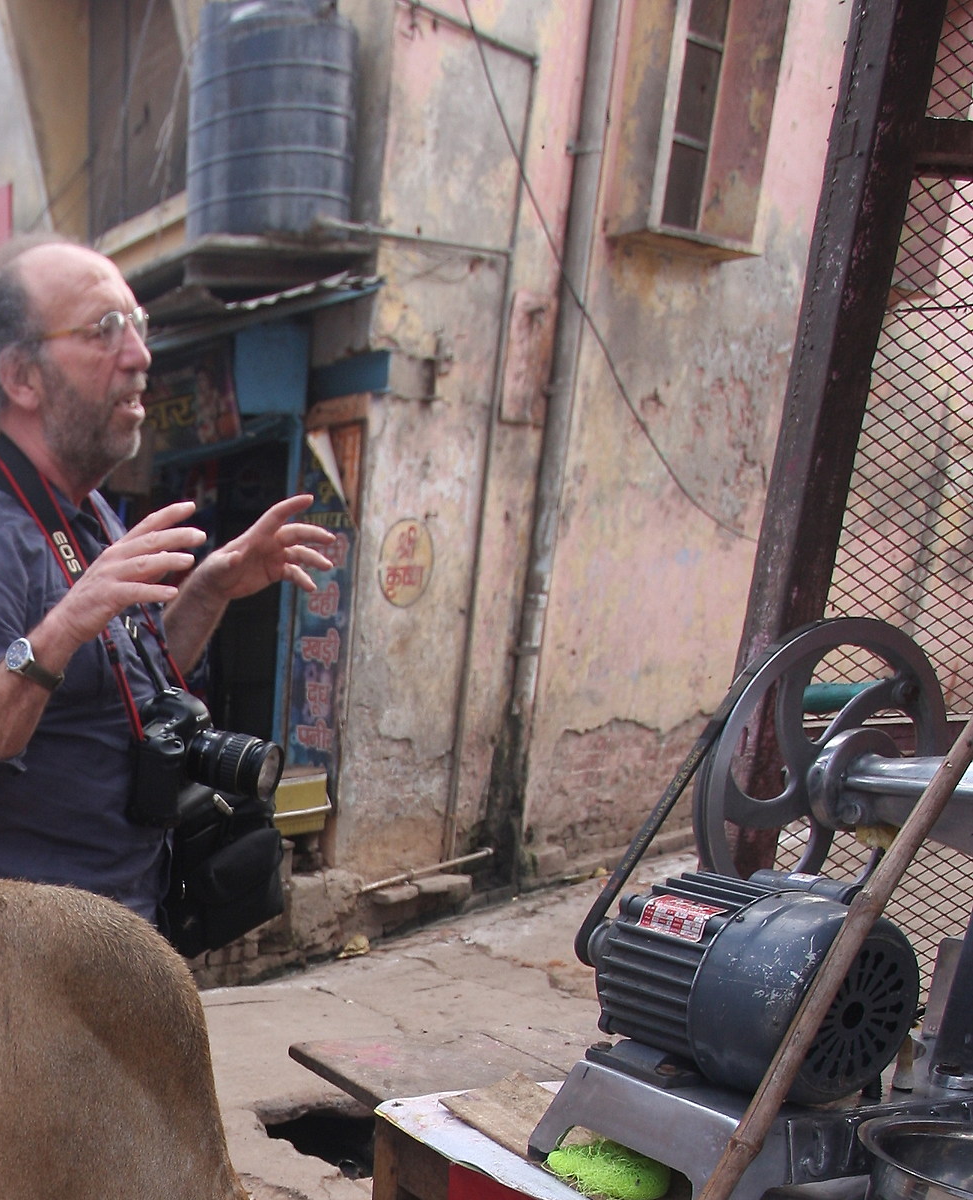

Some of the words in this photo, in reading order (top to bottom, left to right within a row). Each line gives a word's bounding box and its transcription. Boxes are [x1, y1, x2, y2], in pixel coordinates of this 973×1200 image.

[52, 530, 82, 574] EOS
[307, 580, 339, 617] दही
[306, 680, 332, 718] दूध
